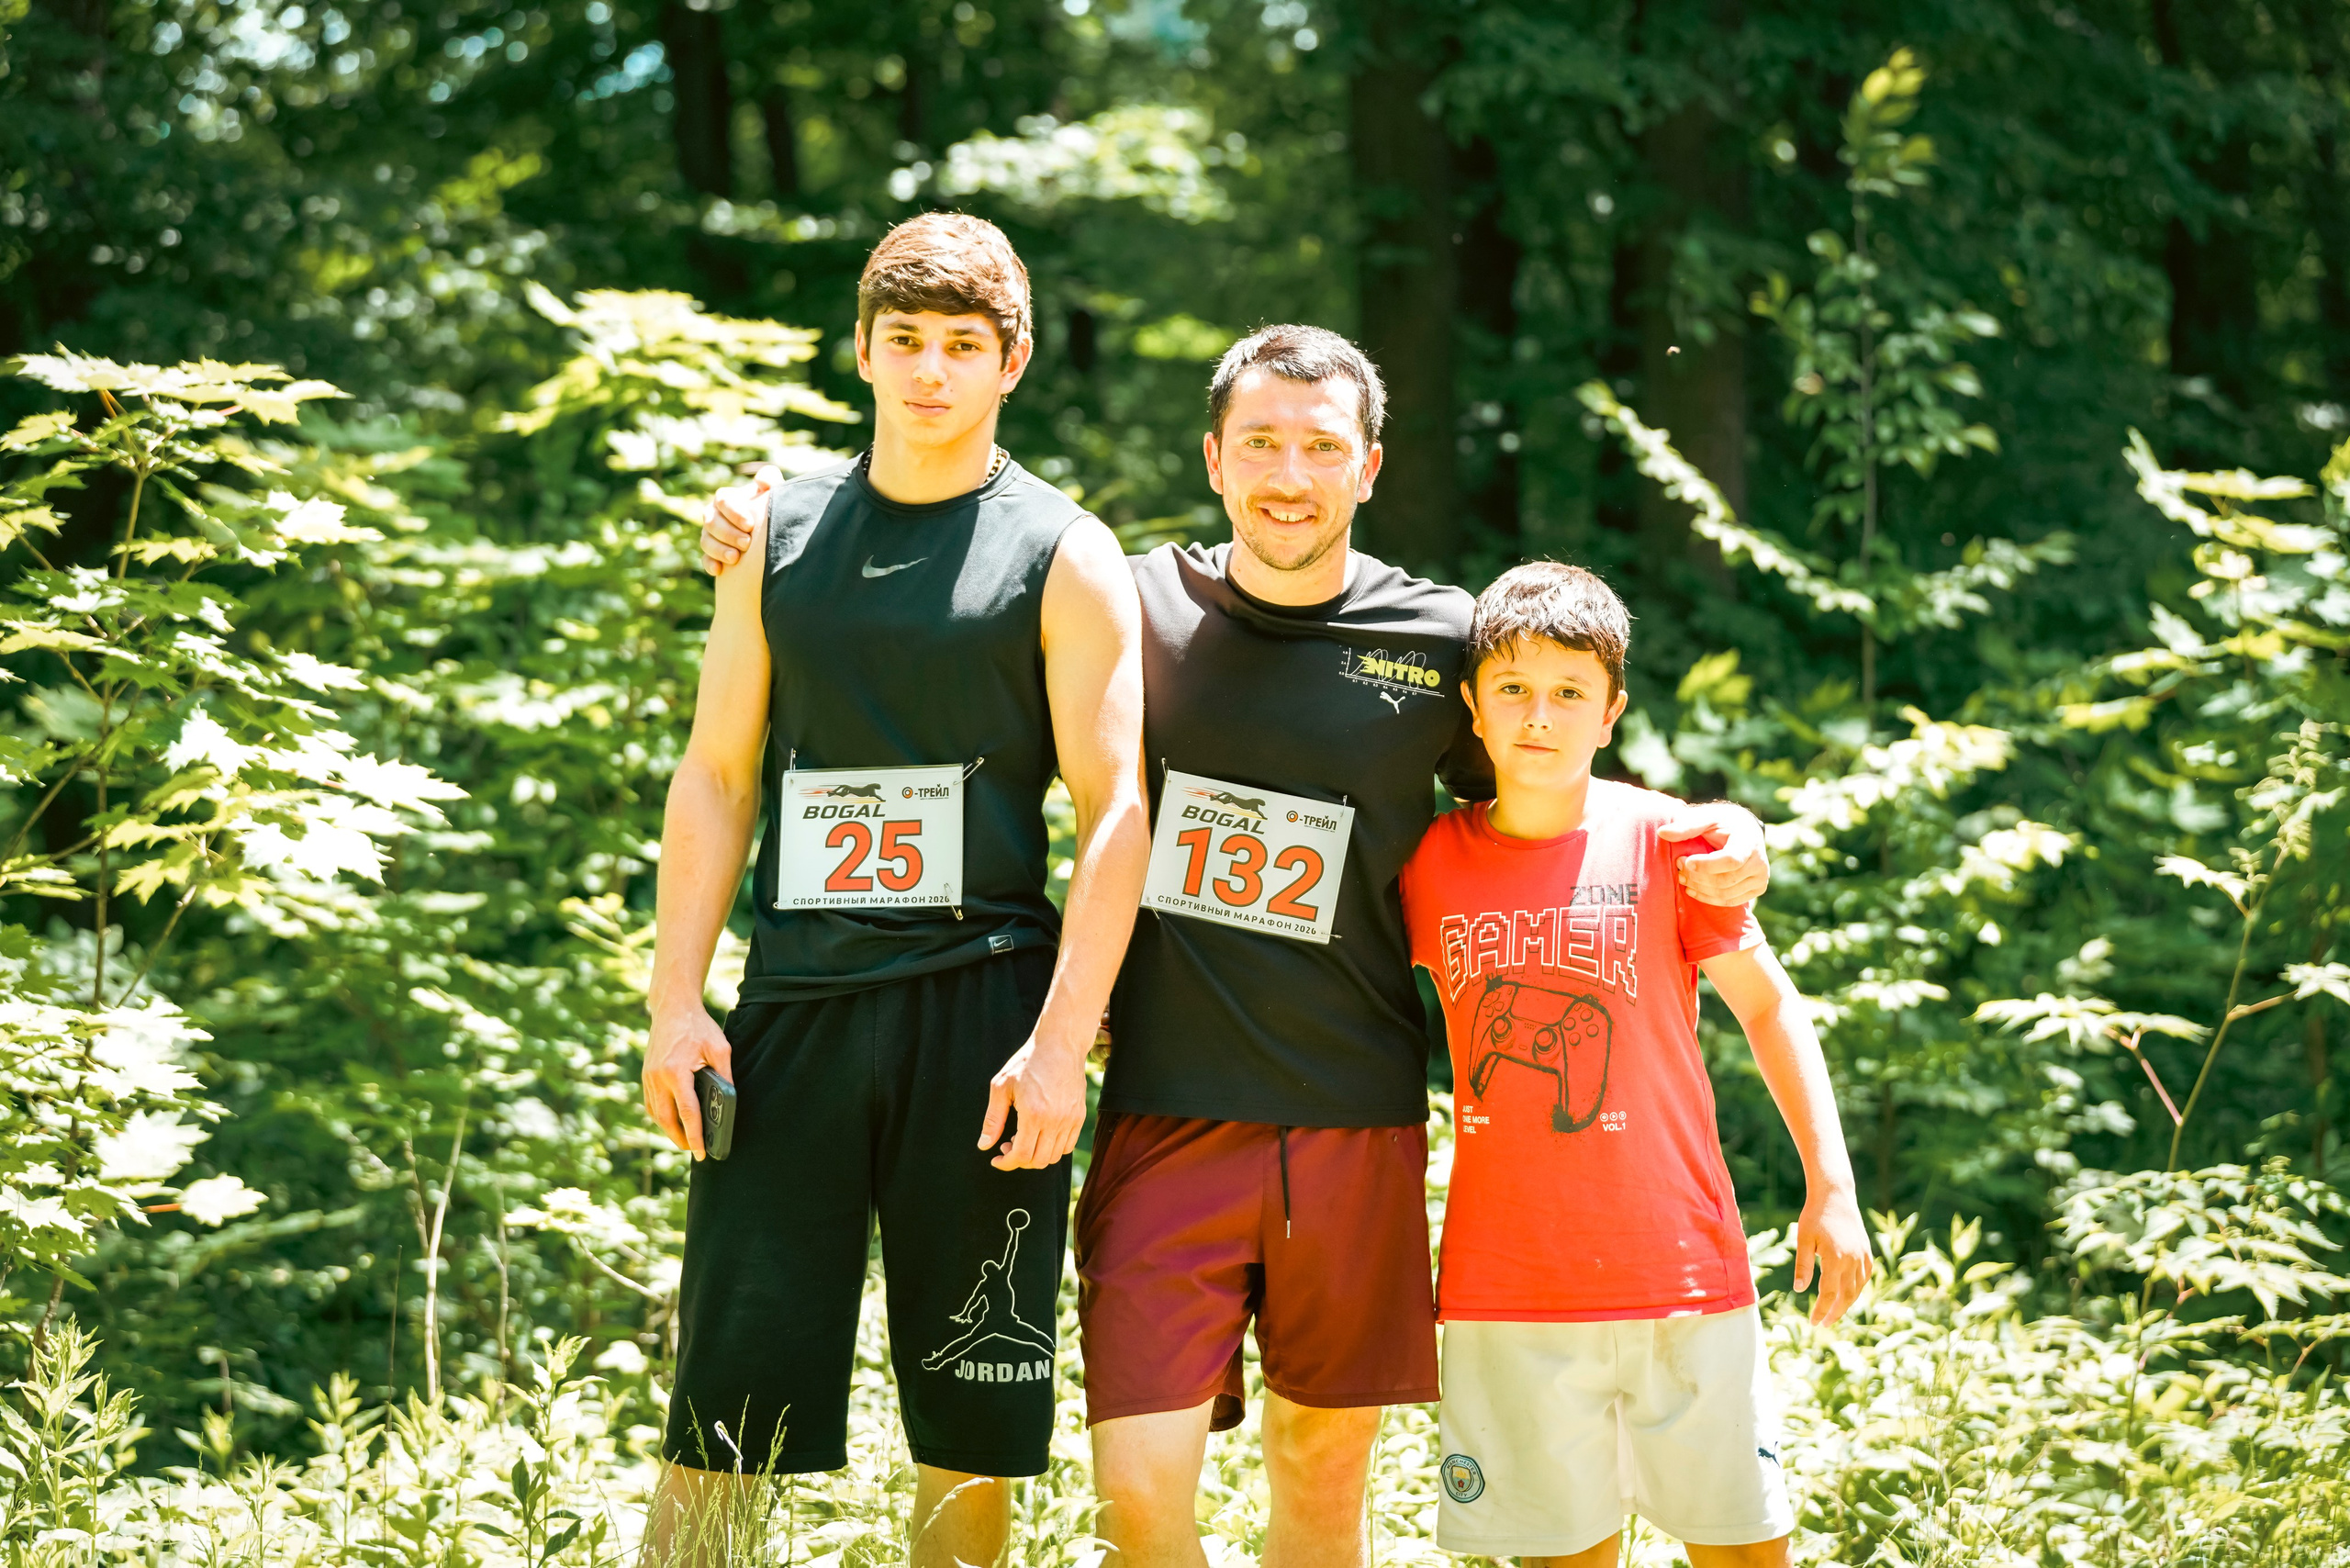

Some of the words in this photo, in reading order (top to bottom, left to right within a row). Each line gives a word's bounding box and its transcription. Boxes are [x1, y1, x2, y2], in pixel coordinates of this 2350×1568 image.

[1357, 655, 1440, 688] NITRO
[802, 803, 886, 820] BOGAL
[1181, 804, 1265, 834] BOGAL
[824, 819, 923, 893] 25
[1176, 826, 1325, 923] 132
[792, 896, 867, 906] СПОРТИВНЫЙ
[869, 895, 926, 904] МАРАФОН
[928, 894, 950, 903] 2026
[1569, 883, 1639, 907] ZONE
[1158, 894, 1231, 918] СПОРТИВНЫЙ
[1233, 912, 1292, 930] МАРАФОН
[1294, 924, 1317, 935] 2026
[1440, 905, 1638, 1007] GAMER
[1472, 1115, 1490, 1124] MORE
[1602, 1122, 1627, 1132] VOL.1
[955, 1359, 1051, 1383] JORDAN
[1447, 1459, 1477, 1475] MANCHESTER
